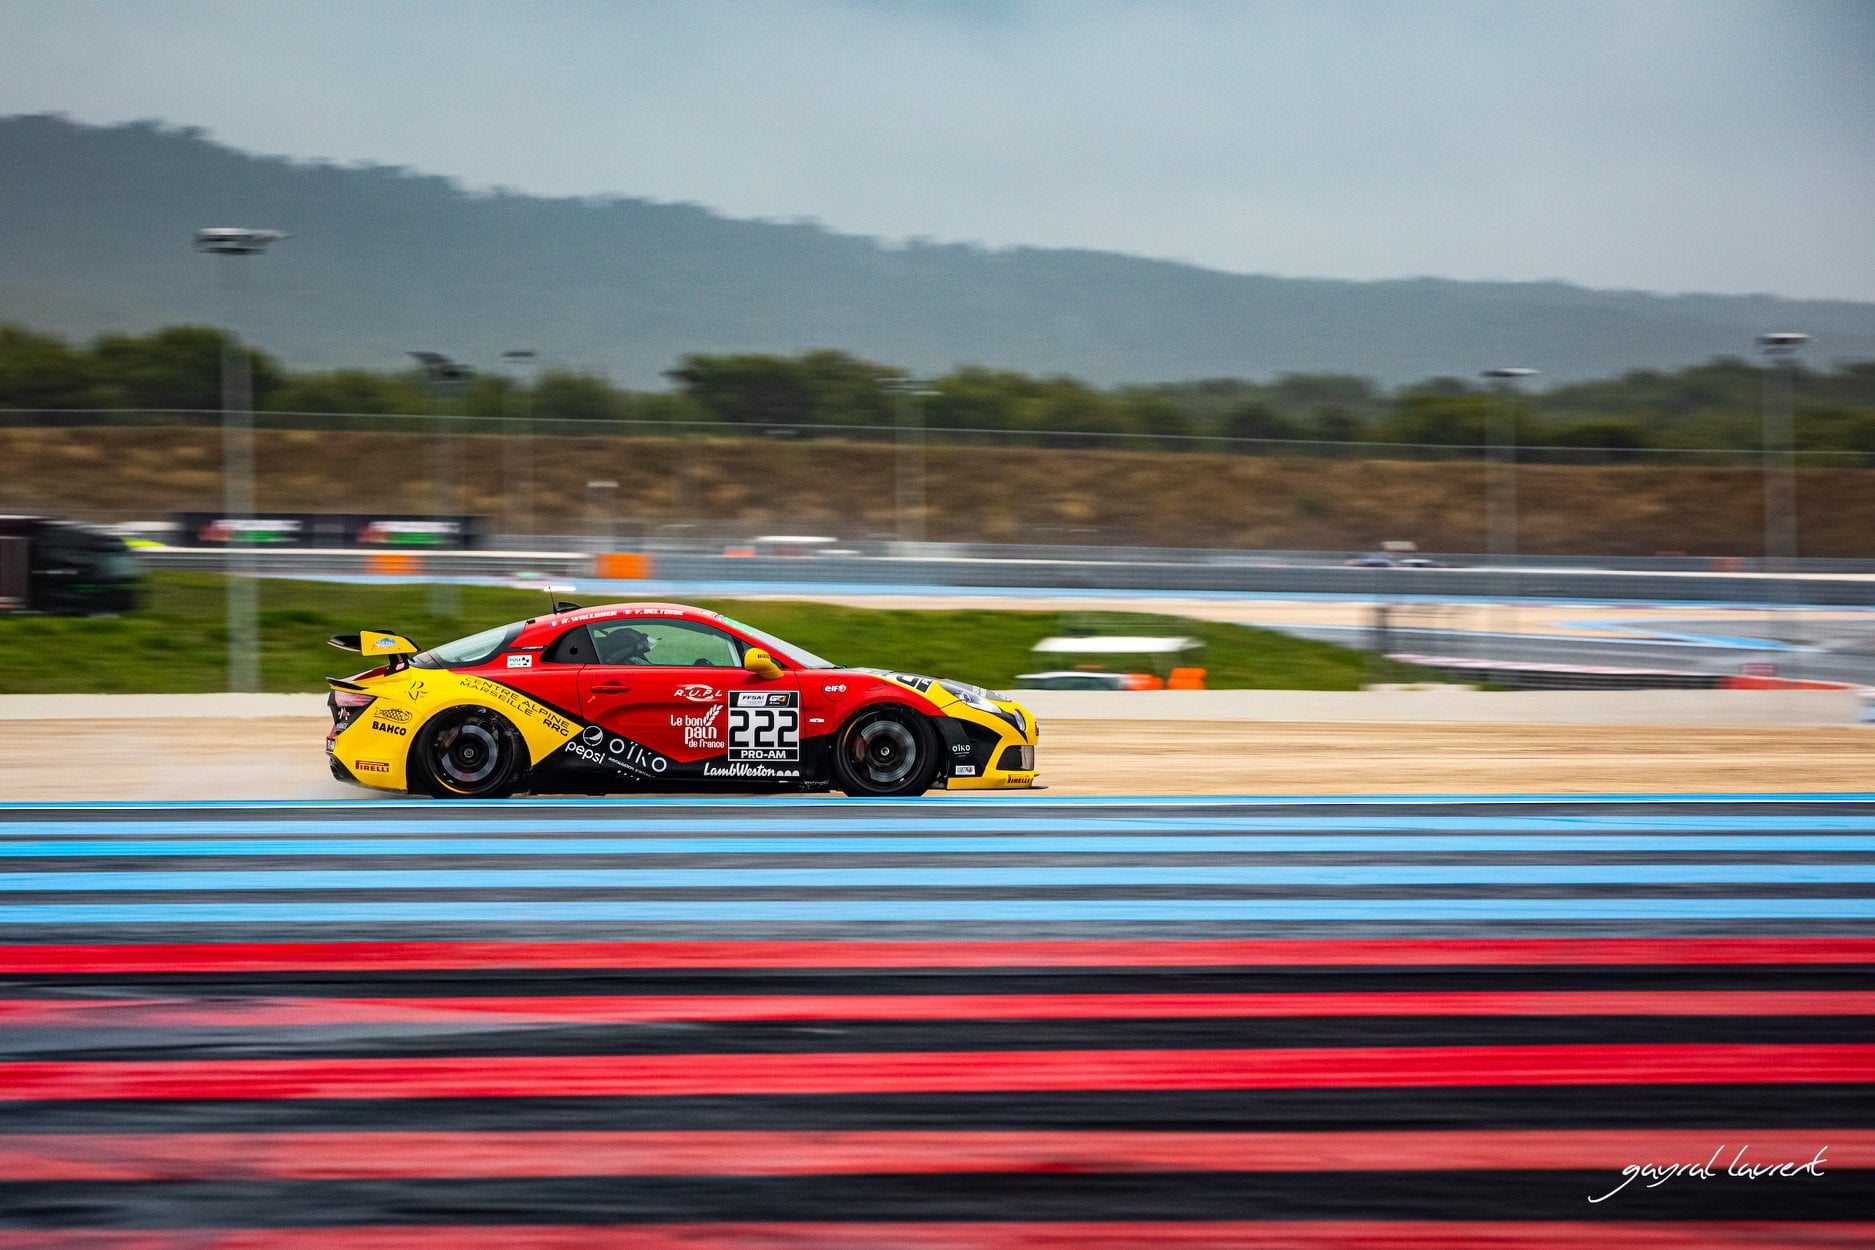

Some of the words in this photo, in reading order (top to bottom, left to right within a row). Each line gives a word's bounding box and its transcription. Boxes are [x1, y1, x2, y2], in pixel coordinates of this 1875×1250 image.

[459, 681, 534, 717] MARSEILLE
[542, 718, 570, 738] RRG
[465, 677, 520, 701] CENTRE
[521, 700, 570, 729] ALPINE
[371, 720, 407, 736] BAHCO
[670, 714, 683, 727] Le
[685, 714, 704, 727] bon
[729, 710, 798, 748] 222
[684, 726, 718, 745] pain
[688, 739, 698, 748] de
[699, 739, 725, 749] france
[564, 741, 606, 765] pepsi
[740, 750, 787, 759] PRO-AM
[355, 759, 390, 773] PIRELLI
